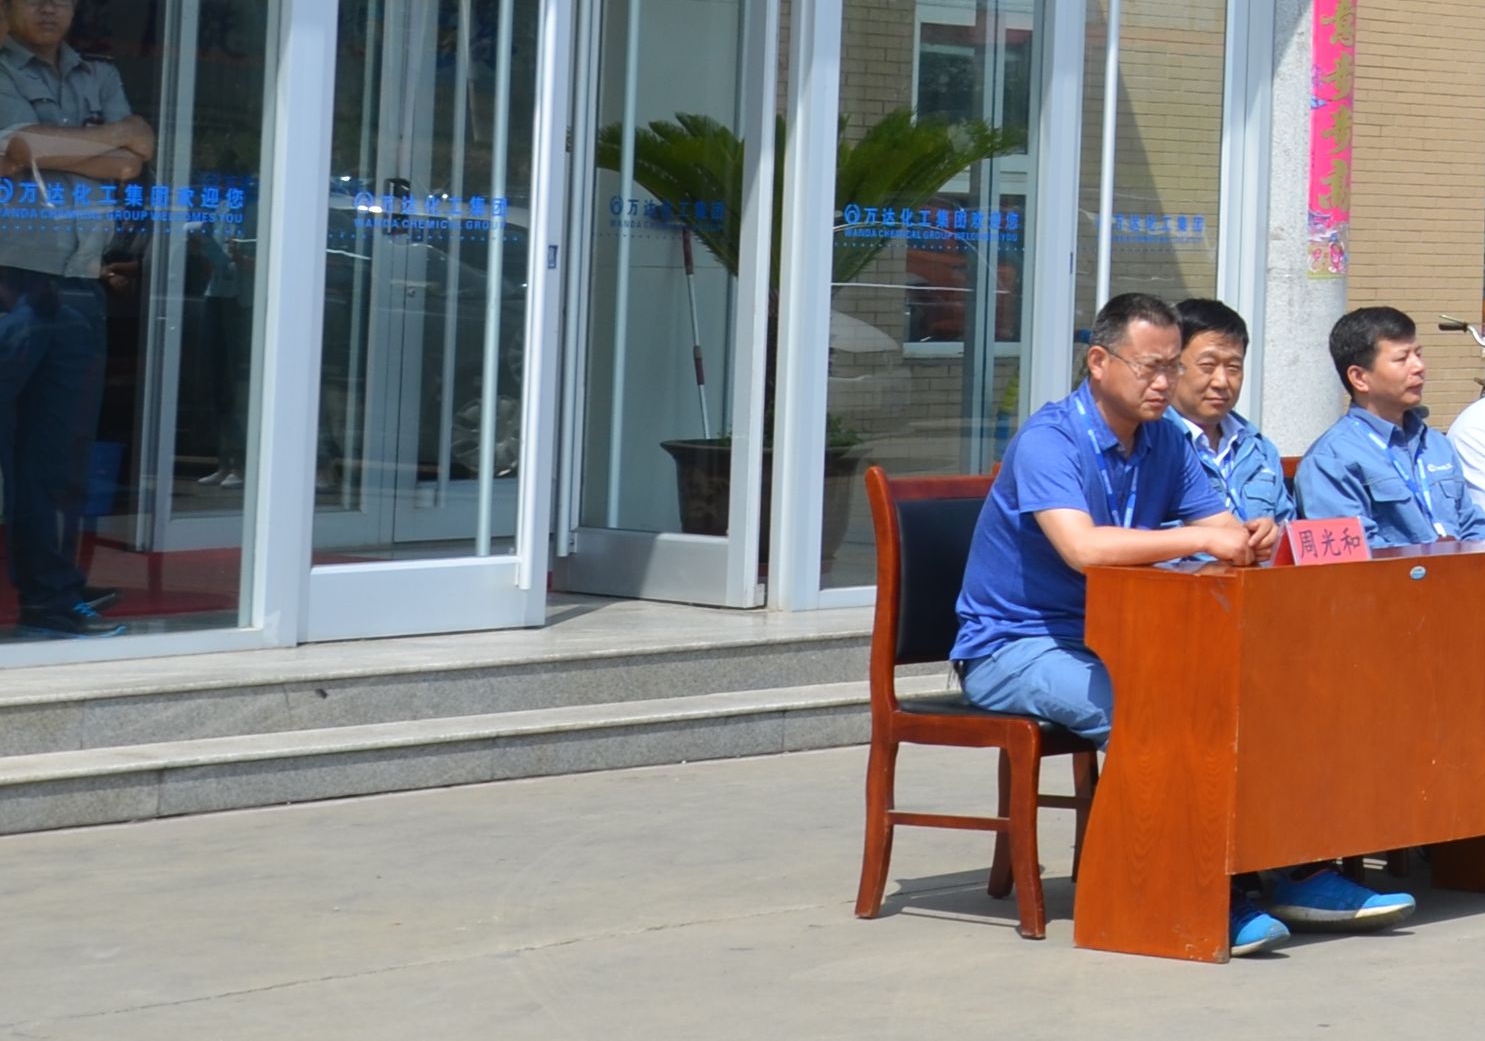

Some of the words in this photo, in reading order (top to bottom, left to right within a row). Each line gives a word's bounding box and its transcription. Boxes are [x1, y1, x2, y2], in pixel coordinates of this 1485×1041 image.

[18, 182, 245, 209] 万达化工集团欢迎您
[1298, 527, 1361, 559] 周光和
